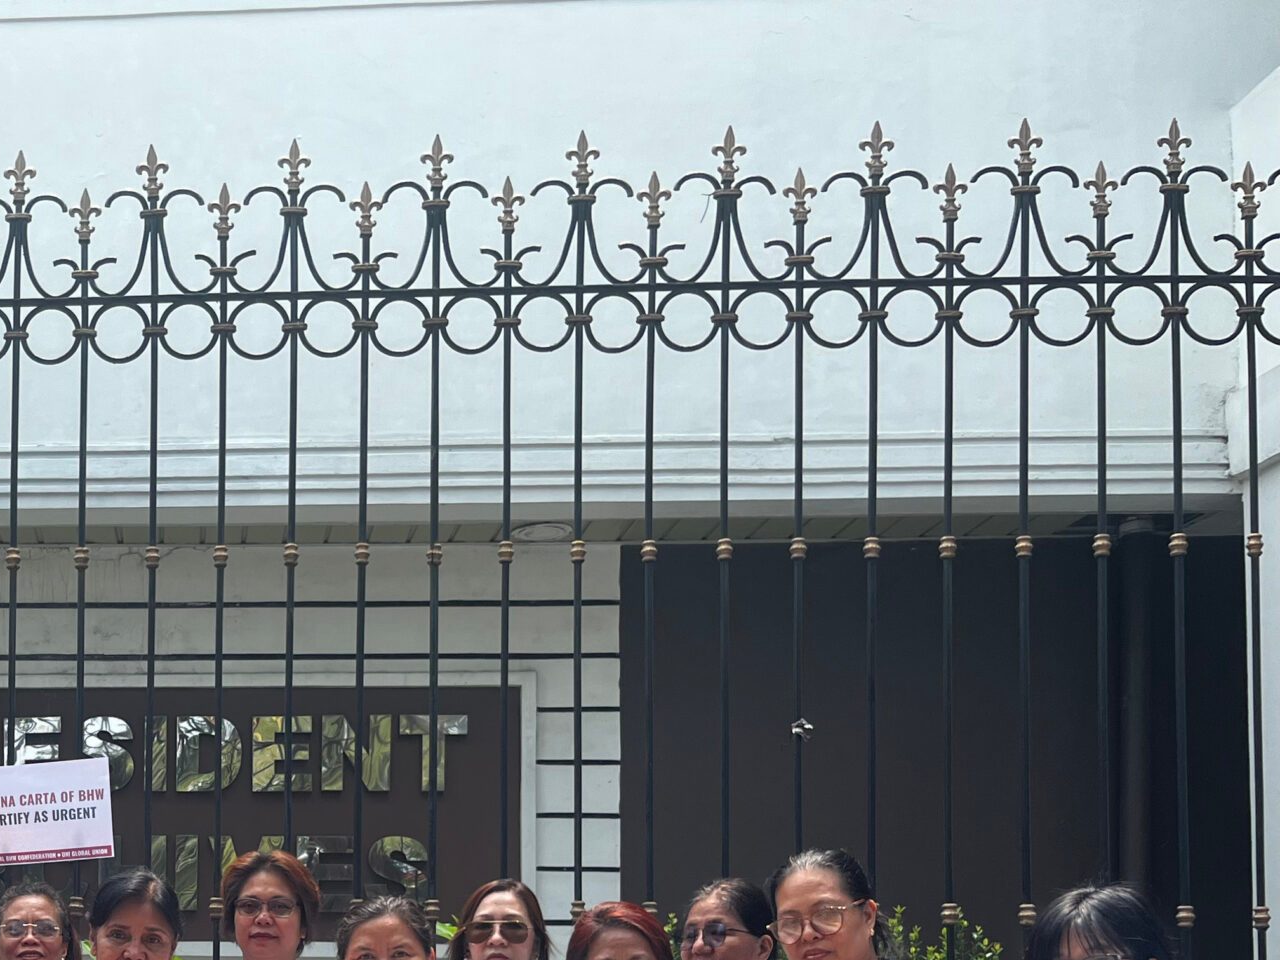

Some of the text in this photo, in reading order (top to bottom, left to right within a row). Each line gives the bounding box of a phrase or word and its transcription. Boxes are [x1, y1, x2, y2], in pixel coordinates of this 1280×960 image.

[20, 792, 56, 806] CARTA
[61, 791, 74, 803] OF
[79, 788, 104, 801] BHW
[34, 810, 48, 823] AS
[52, 807, 97, 821] URGENT
[18, 853, 56, 861] CONFEDERATION
